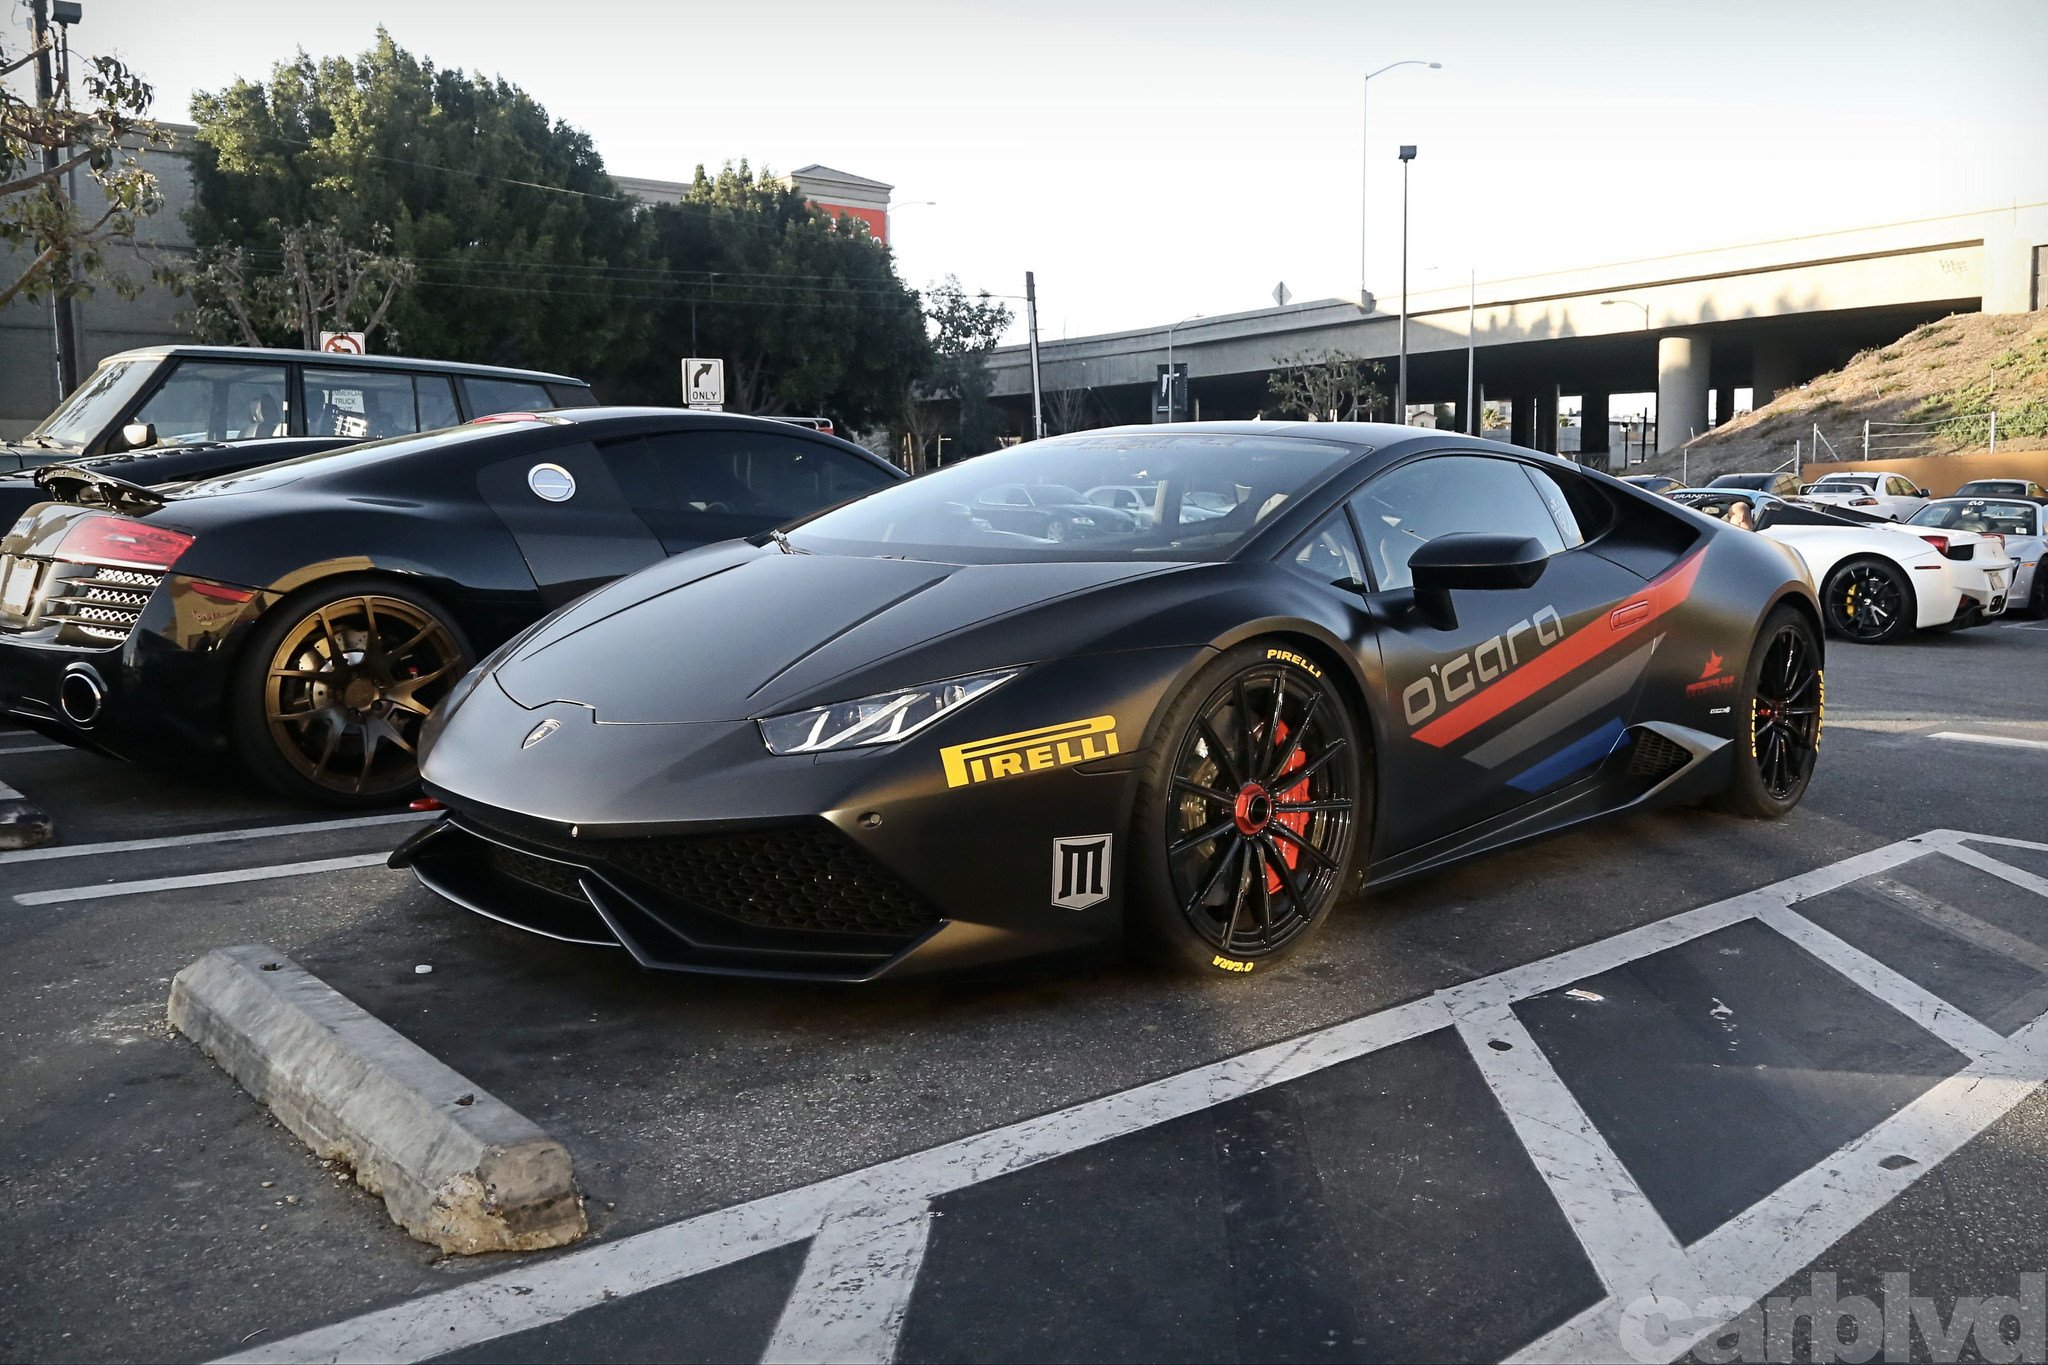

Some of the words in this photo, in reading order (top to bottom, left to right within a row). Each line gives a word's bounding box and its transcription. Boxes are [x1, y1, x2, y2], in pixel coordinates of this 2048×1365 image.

[335, 397, 356, 405] TRUCK
[692, 391, 717, 400] ONLY
[1266, 649, 1322, 678] PIRELLI
[939, 714, 1120, 789] PIRELLI
[1212, 955, 1254, 972] O'GARA
